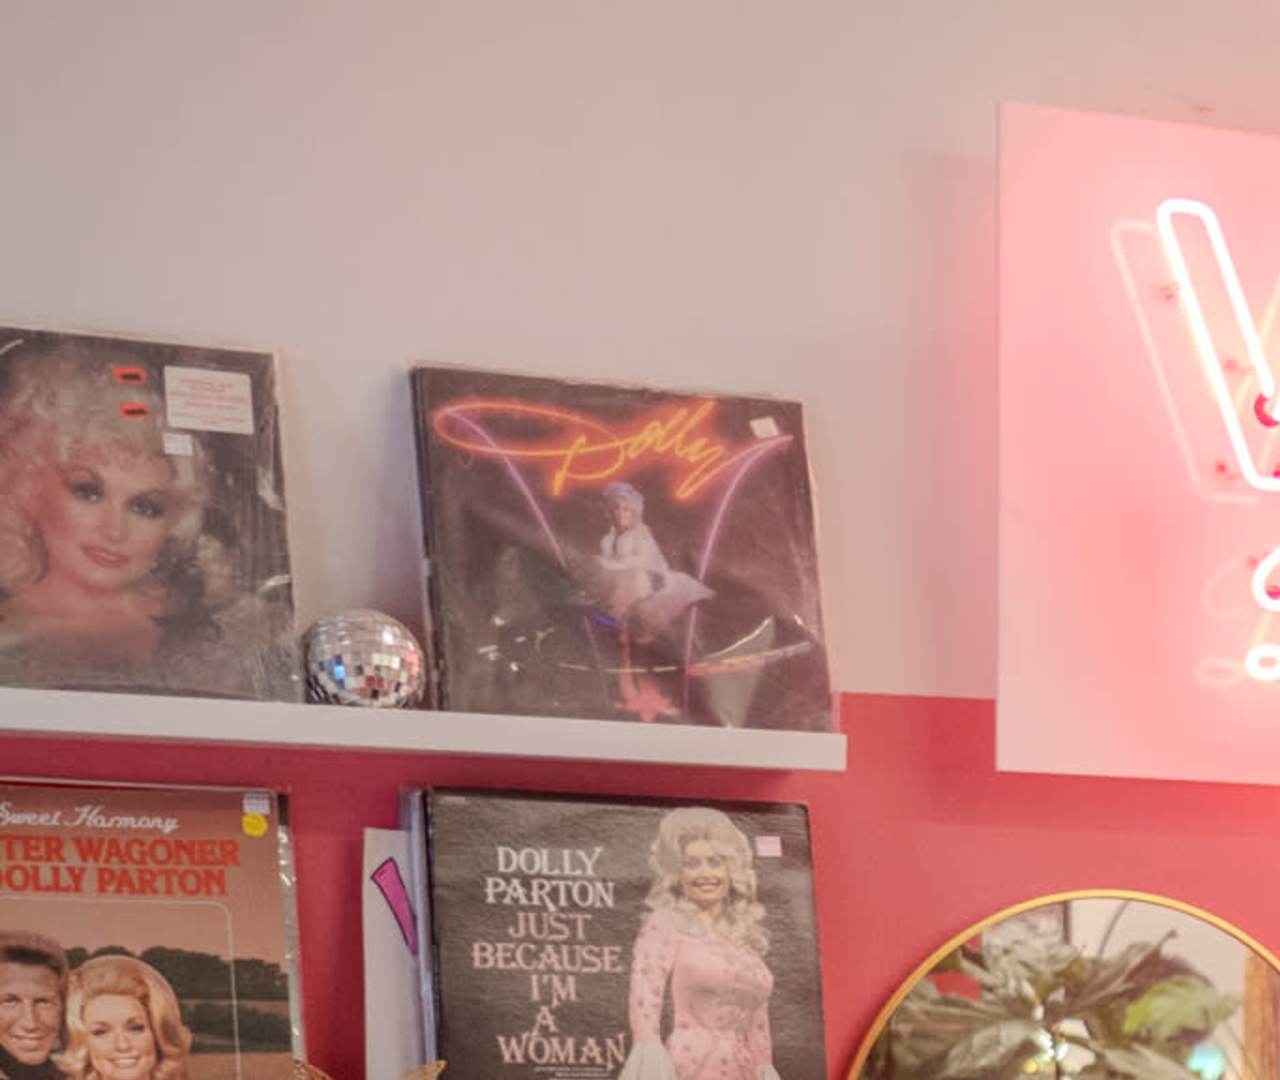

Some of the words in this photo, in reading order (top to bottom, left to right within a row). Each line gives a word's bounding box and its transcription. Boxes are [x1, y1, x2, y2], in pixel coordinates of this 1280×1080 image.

[432, 398, 726, 500] Dolly
[64, 804, 181, 835] Harmony
[72, 837, 241, 868] WAGONER
[496, 846, 604, 877] DOLLY
[0, 864, 86, 894] OLLY
[96, 866, 227, 897] PARTON
[484, 877, 616, 912] PARTON
[507, 911, 593, 942] JUST
[470, 942, 624, 975] BECAUSE
[529, 974, 578, 1009] I'M
[532, 1005, 559, 1037] A
[496, 1031, 627, 1071] WOMAN
